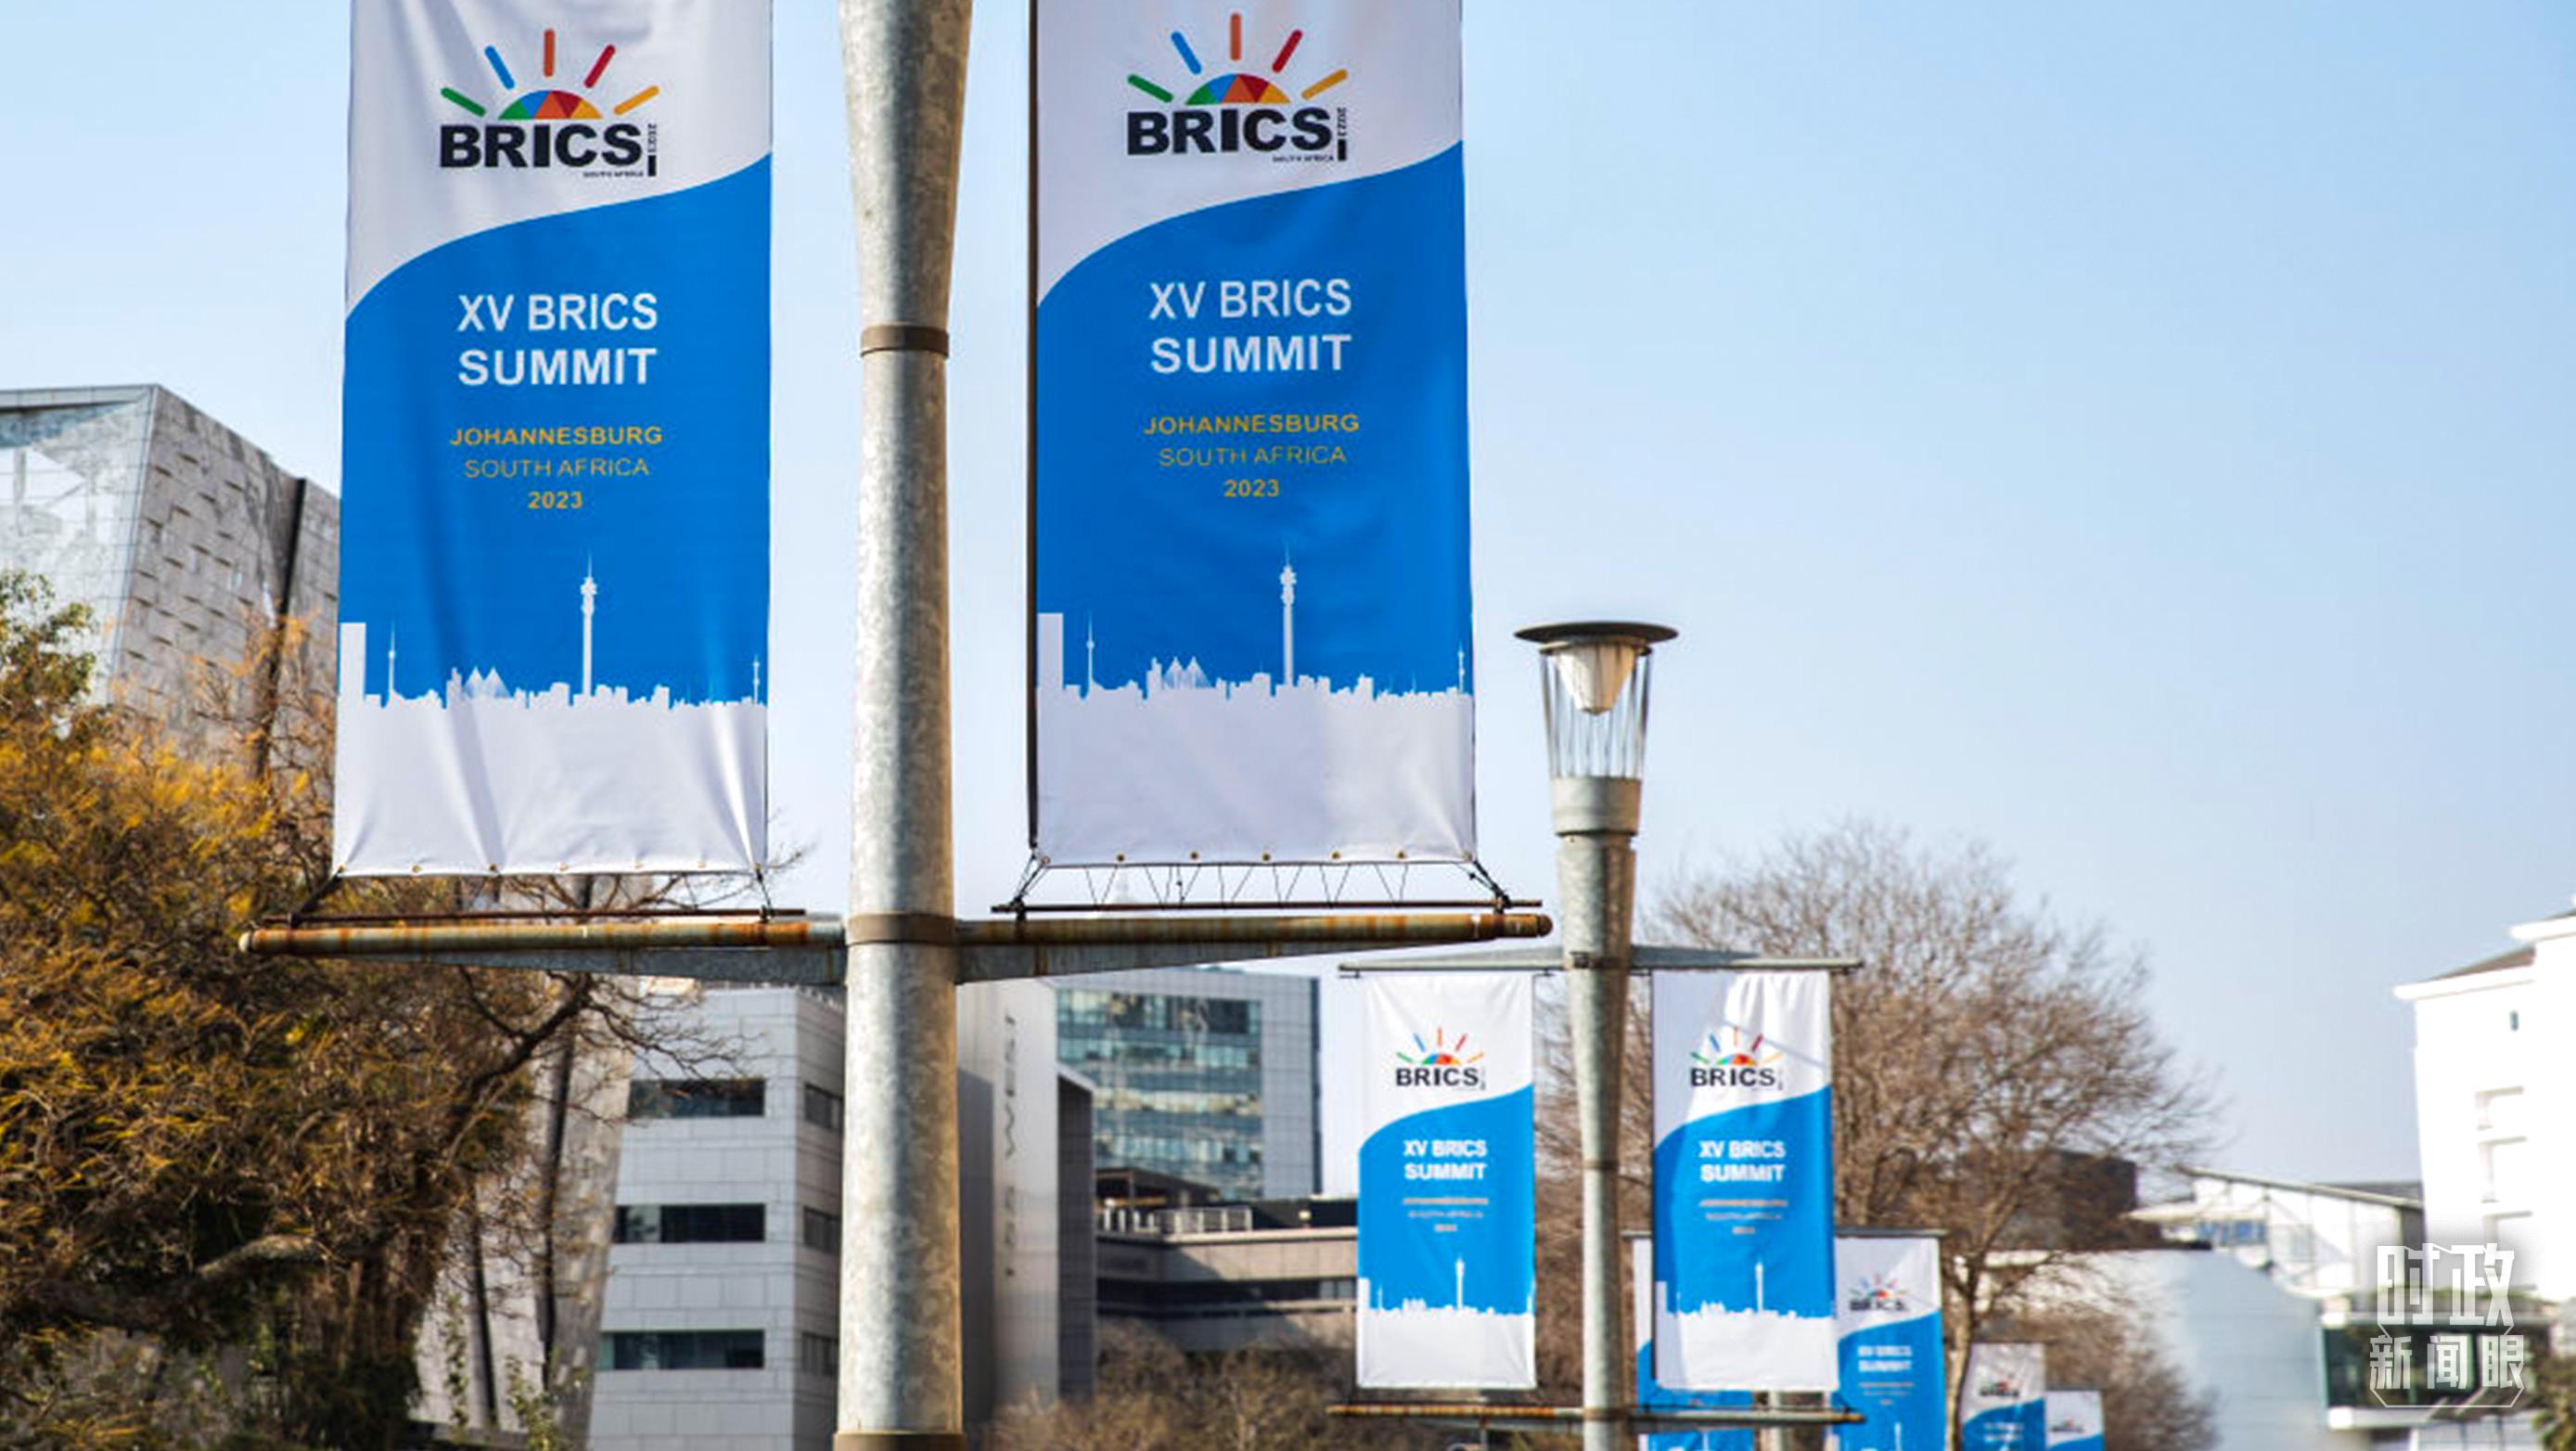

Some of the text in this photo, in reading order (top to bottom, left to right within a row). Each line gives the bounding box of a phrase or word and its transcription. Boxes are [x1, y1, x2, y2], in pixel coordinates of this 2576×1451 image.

[1127, 107, 1333, 156] BRICS
[440, 123, 643, 168] BRICS
[1148, 278, 1352, 320] XV BRICS
[457, 292, 658, 331] XV BRICS
[1151, 334, 1352, 374] SUMMIT
[458, 347, 658, 386] SUMMIT
[1144, 413, 1360, 435] JOHANNESBURG
[450, 426, 662, 446] JOHANNESBURG
[1159, 445, 1346, 468] SOUTH AFRICA
[465, 457, 650, 479] SOUTH AFRICA
[1223, 479, 1280, 497] 2023
[527, 491, 583, 509] 2023
[1395, 1067, 1479, 1087] BRICS
[1690, 1067, 1775, 1087] BRICS
[1403, 1139, 1487, 1158] XV BRICS
[1698, 1139, 1786, 1159] XV BRICS
[1403, 1162, 1488, 1180] SUMMIT
[1699, 1163, 1786, 1182] SUMMIT
